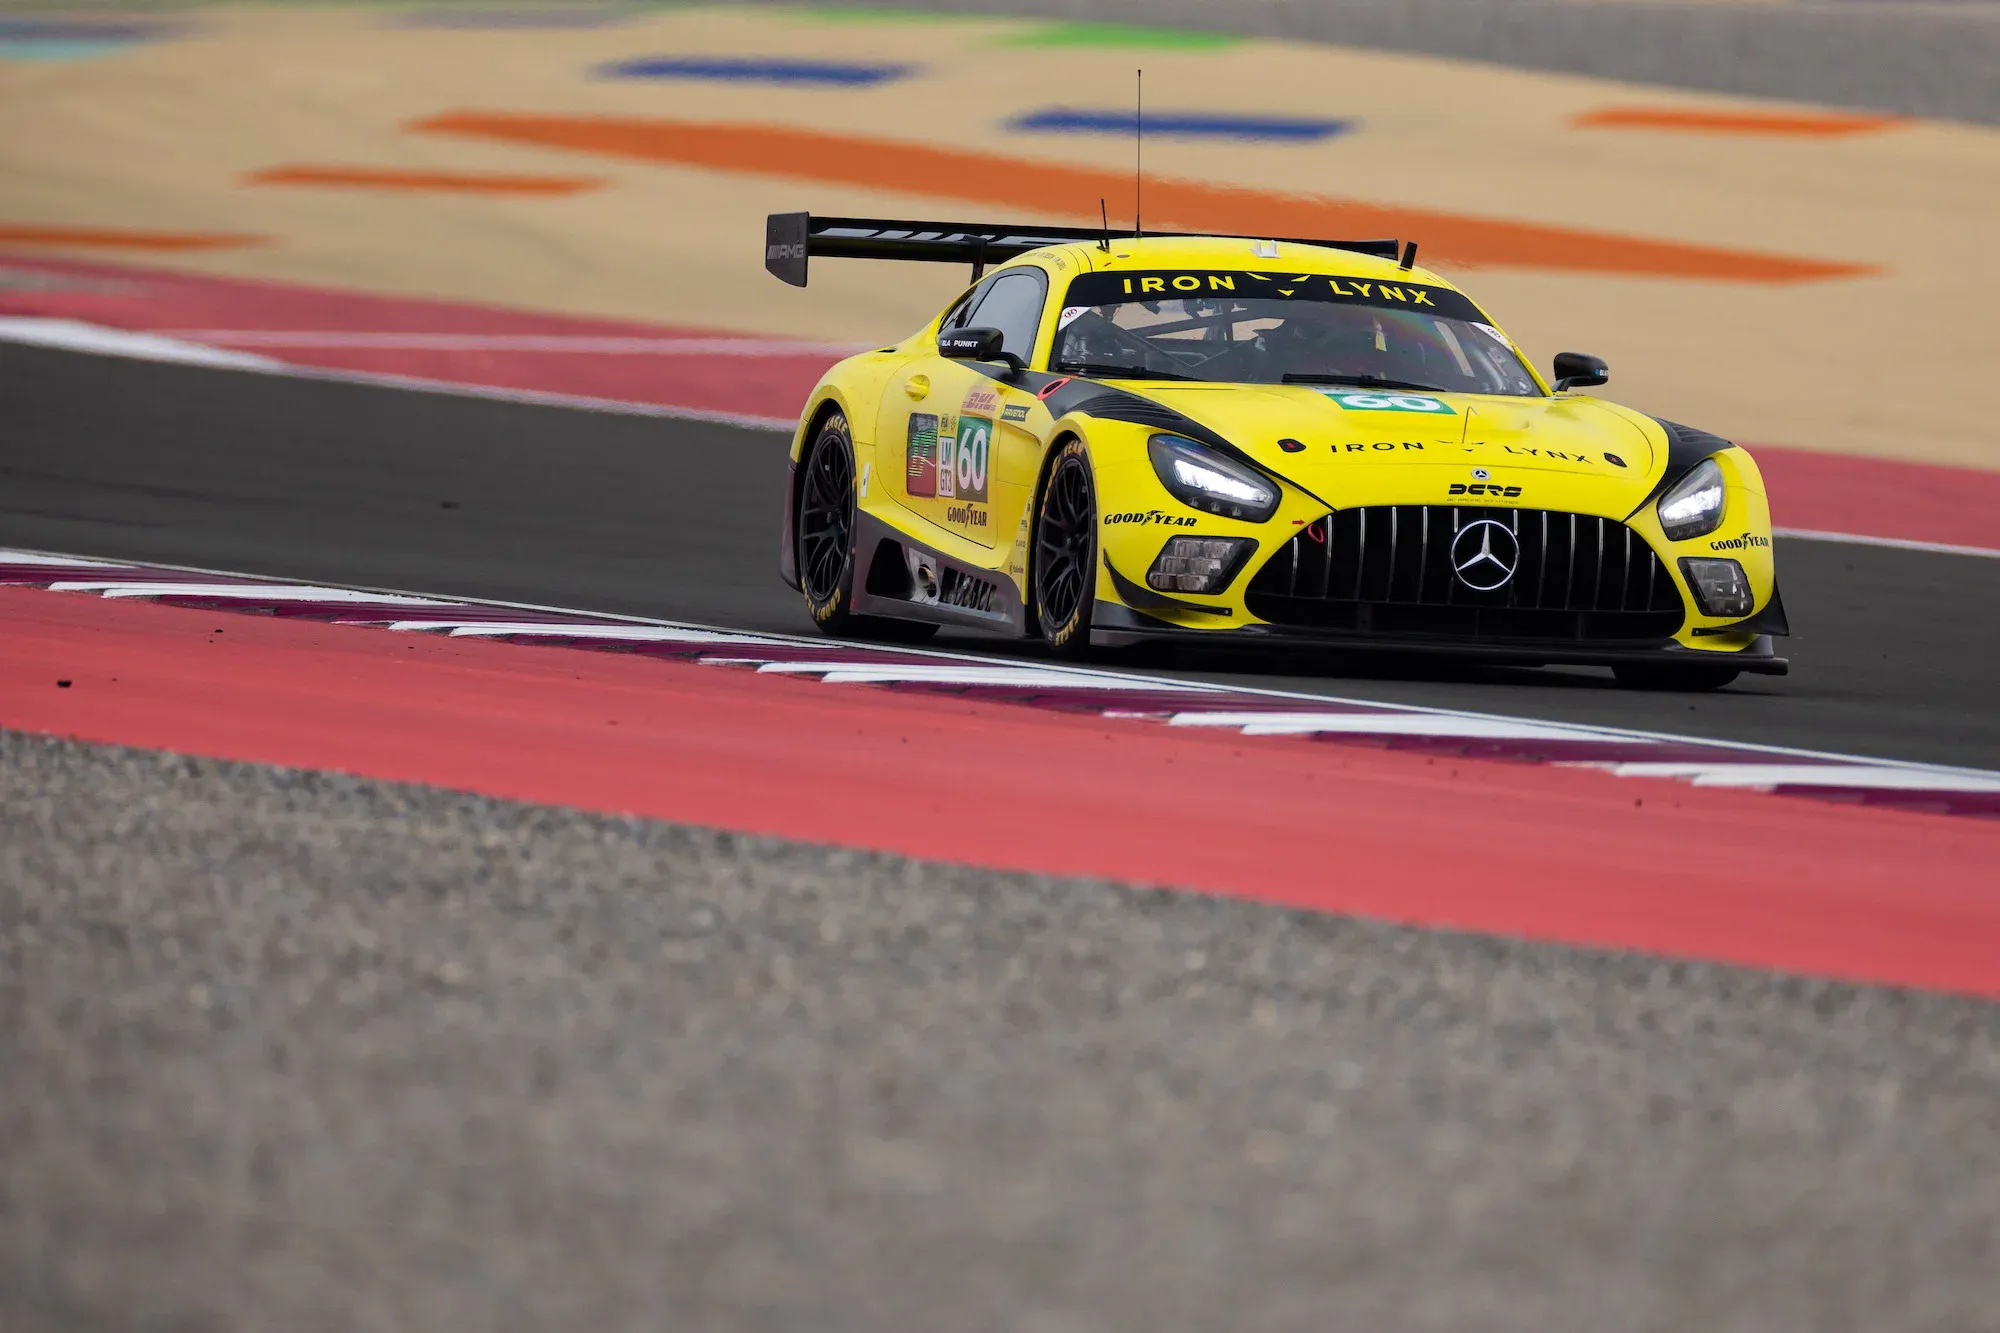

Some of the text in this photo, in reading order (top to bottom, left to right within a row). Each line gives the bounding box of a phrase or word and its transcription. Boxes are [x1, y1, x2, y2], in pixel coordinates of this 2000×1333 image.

[1123, 274, 1435, 307] IRON LYNX
[1341, 395, 1441, 411] 60
[824, 415, 848, 436] EAGLE
[941, 441, 952, 466] LM
[958, 428, 987, 492] 60
[1331, 442, 1593, 464] IRON LYNX
[940, 468, 952, 492] GT3
